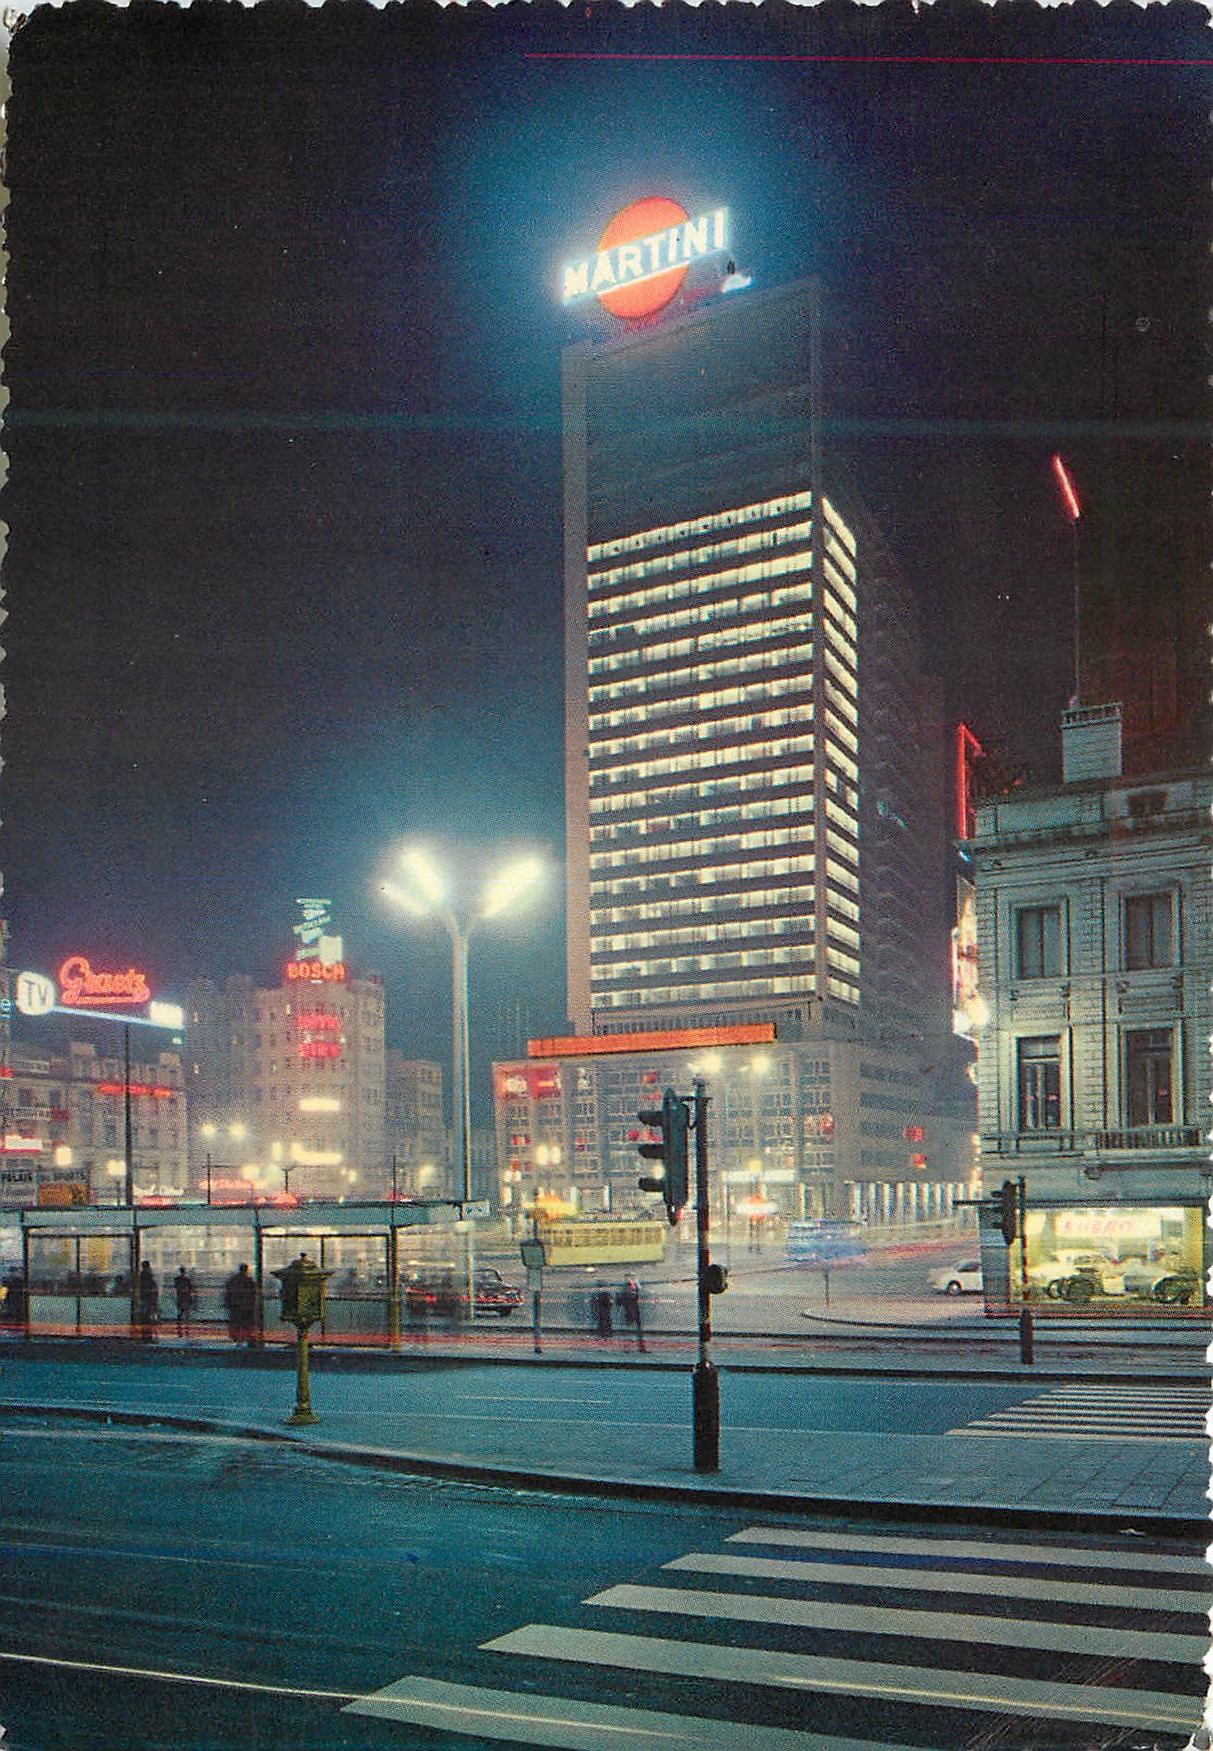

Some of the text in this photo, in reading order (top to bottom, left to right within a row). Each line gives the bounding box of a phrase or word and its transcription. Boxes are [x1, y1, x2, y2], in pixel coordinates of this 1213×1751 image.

[563, 207, 729, 303] MARTINI
[287, 962, 345, 980] BOSCH
[24, 979, 49, 1007] TV
